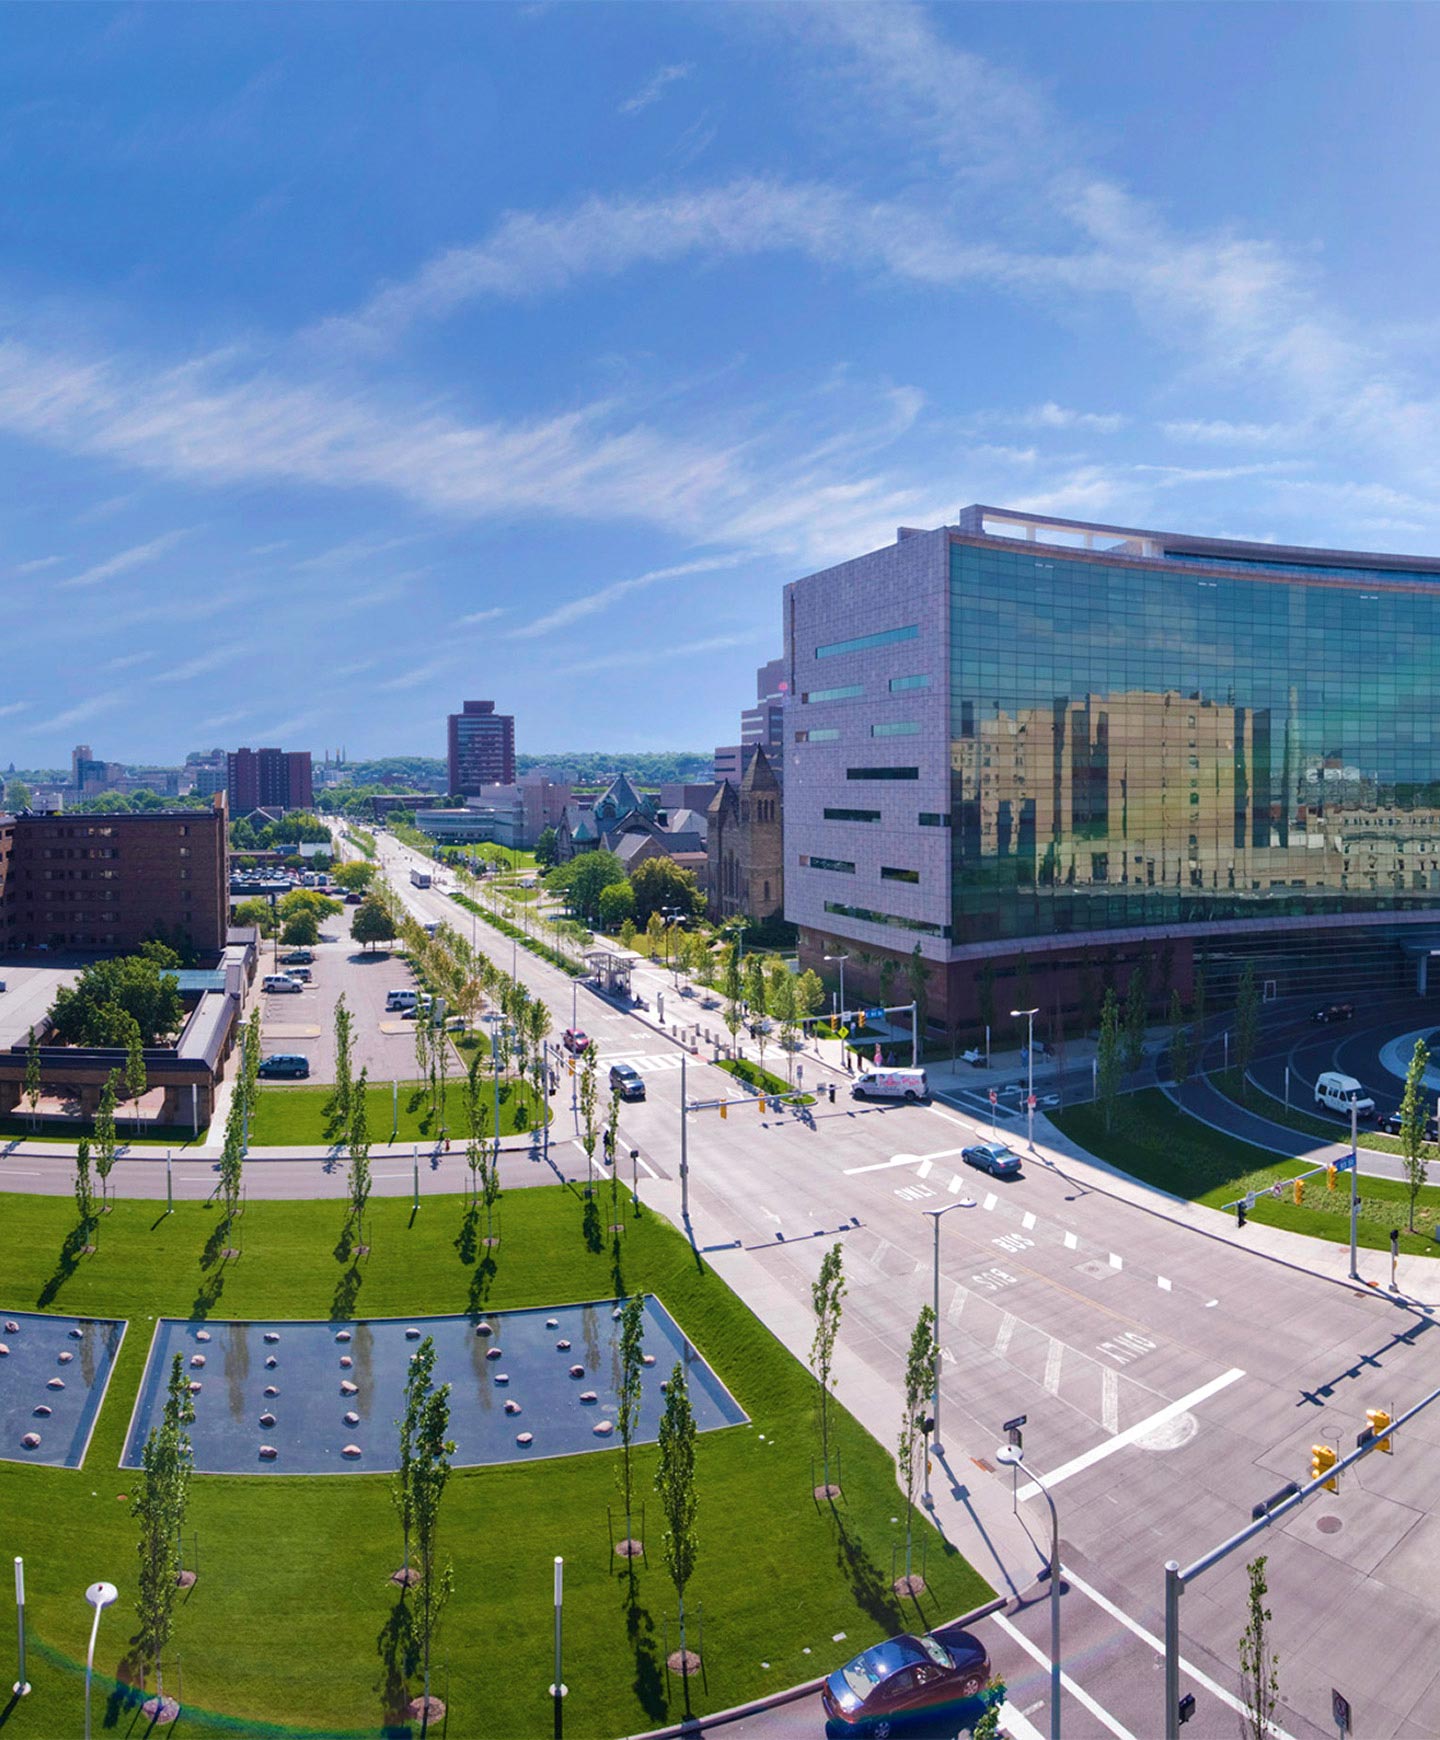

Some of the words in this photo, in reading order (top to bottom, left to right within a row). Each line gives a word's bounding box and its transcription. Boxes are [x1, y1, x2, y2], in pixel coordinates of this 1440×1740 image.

[893, 1184, 937, 1201] ONLY
[991, 1232, 1036, 1253] BUS
[971, 1267, 1018, 1291] BUS
[1095, 1331, 1157, 1365] ONLY
